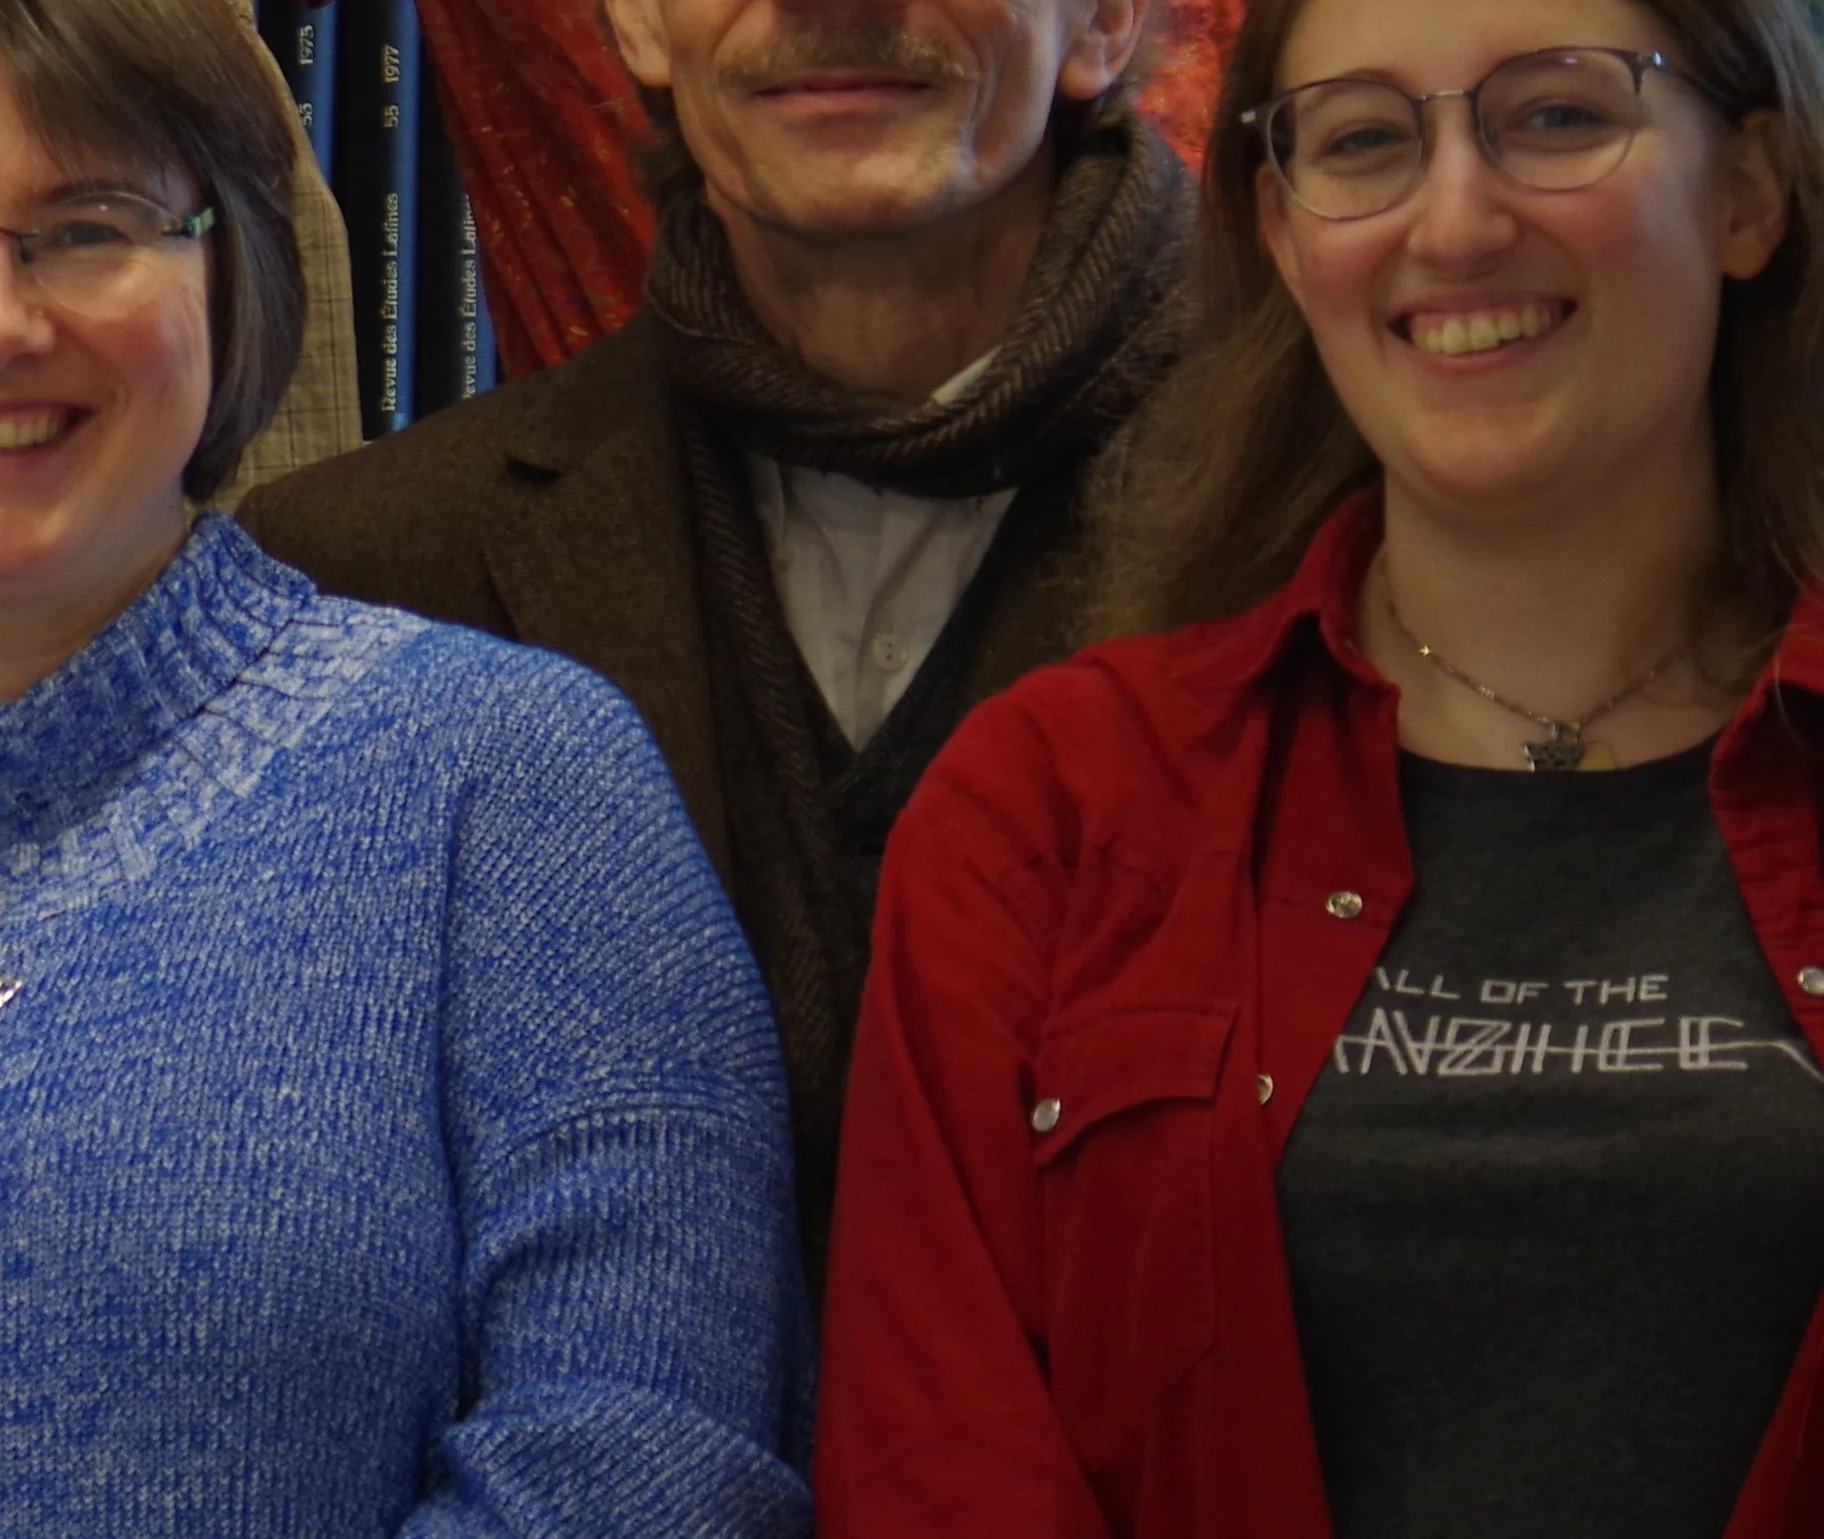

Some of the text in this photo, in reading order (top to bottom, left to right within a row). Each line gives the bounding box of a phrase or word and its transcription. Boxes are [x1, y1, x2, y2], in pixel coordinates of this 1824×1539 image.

[300, 24, 314, 65] 1975
[384, 45, 400, 84] 1977
[385, 104, 399, 128] 55
[382, 193, 398, 257] Latines
[382, 324, 397, 354] des
[462, 321, 477, 352] des
[381, 357, 397, 411] Revue
[1480, 978, 1548, 1005] OF
[1563, 974, 1669, 1005] THE
